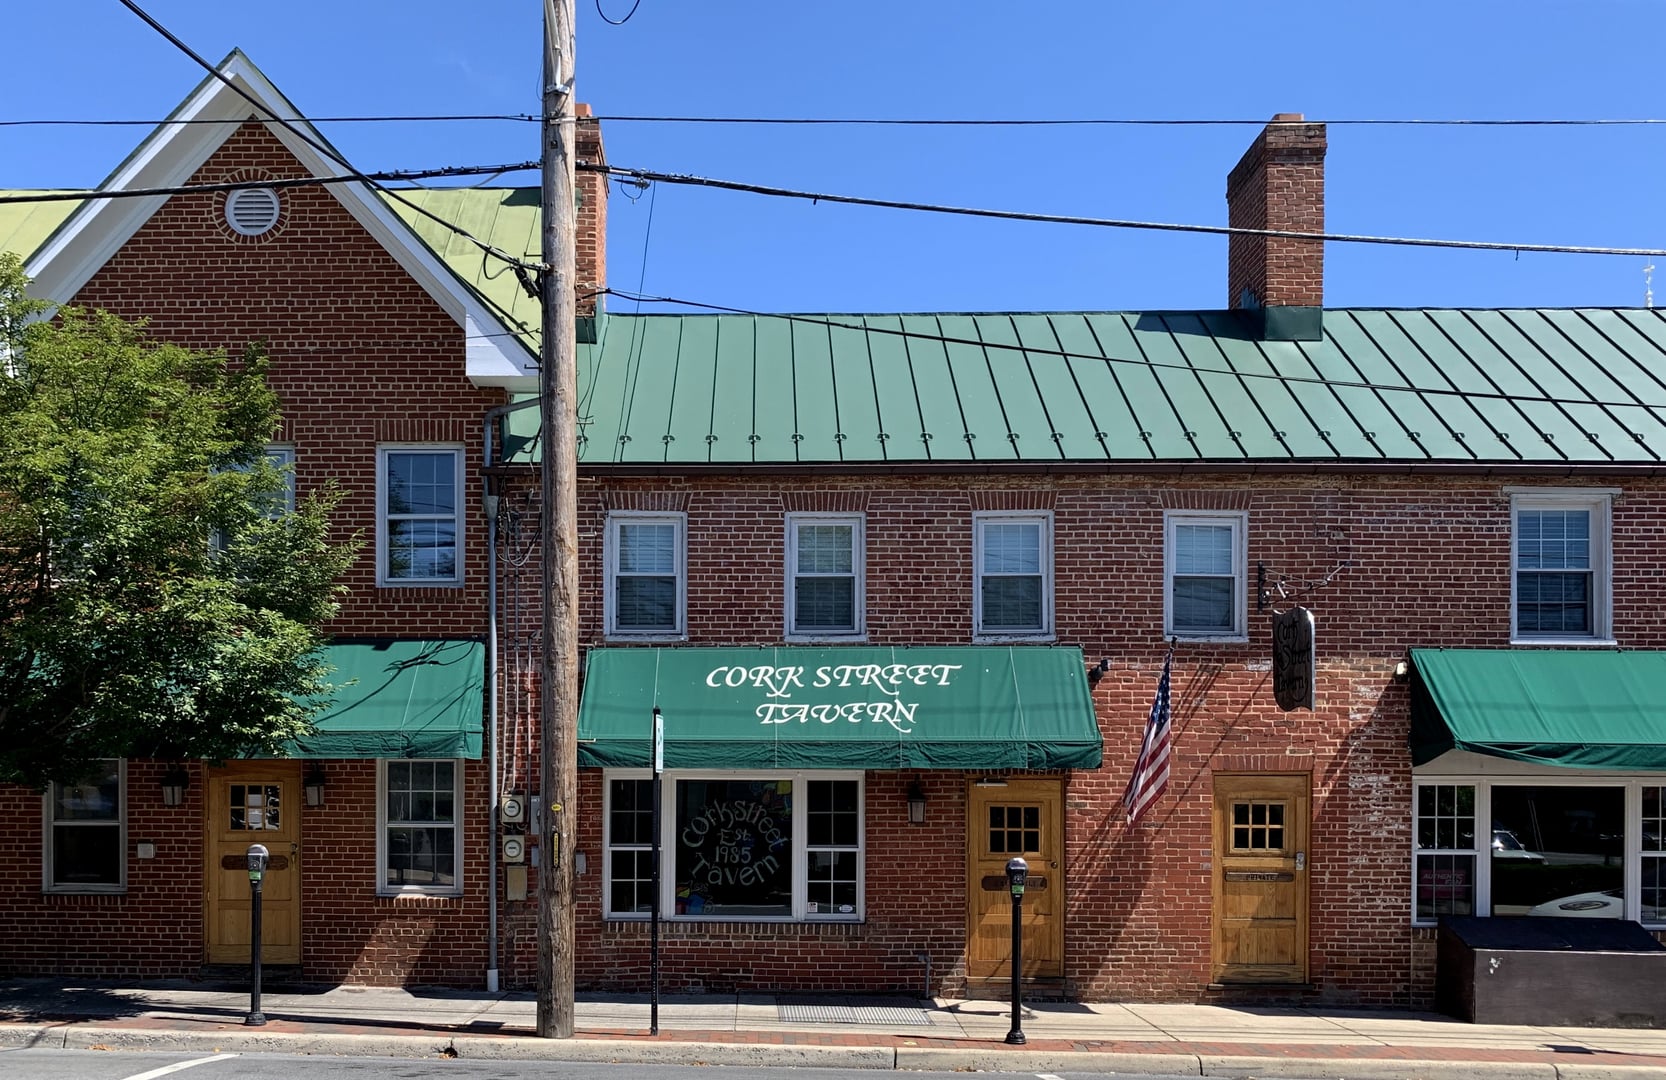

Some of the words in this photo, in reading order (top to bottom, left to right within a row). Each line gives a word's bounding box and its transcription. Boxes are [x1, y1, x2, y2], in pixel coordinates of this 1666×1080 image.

[706, 665, 805, 698] CORK
[813, 664, 962, 696] STREET
[755, 698, 919, 733] TAVERN
[691, 851, 780, 886] Tavern
[715, 845, 752, 864] 1985
